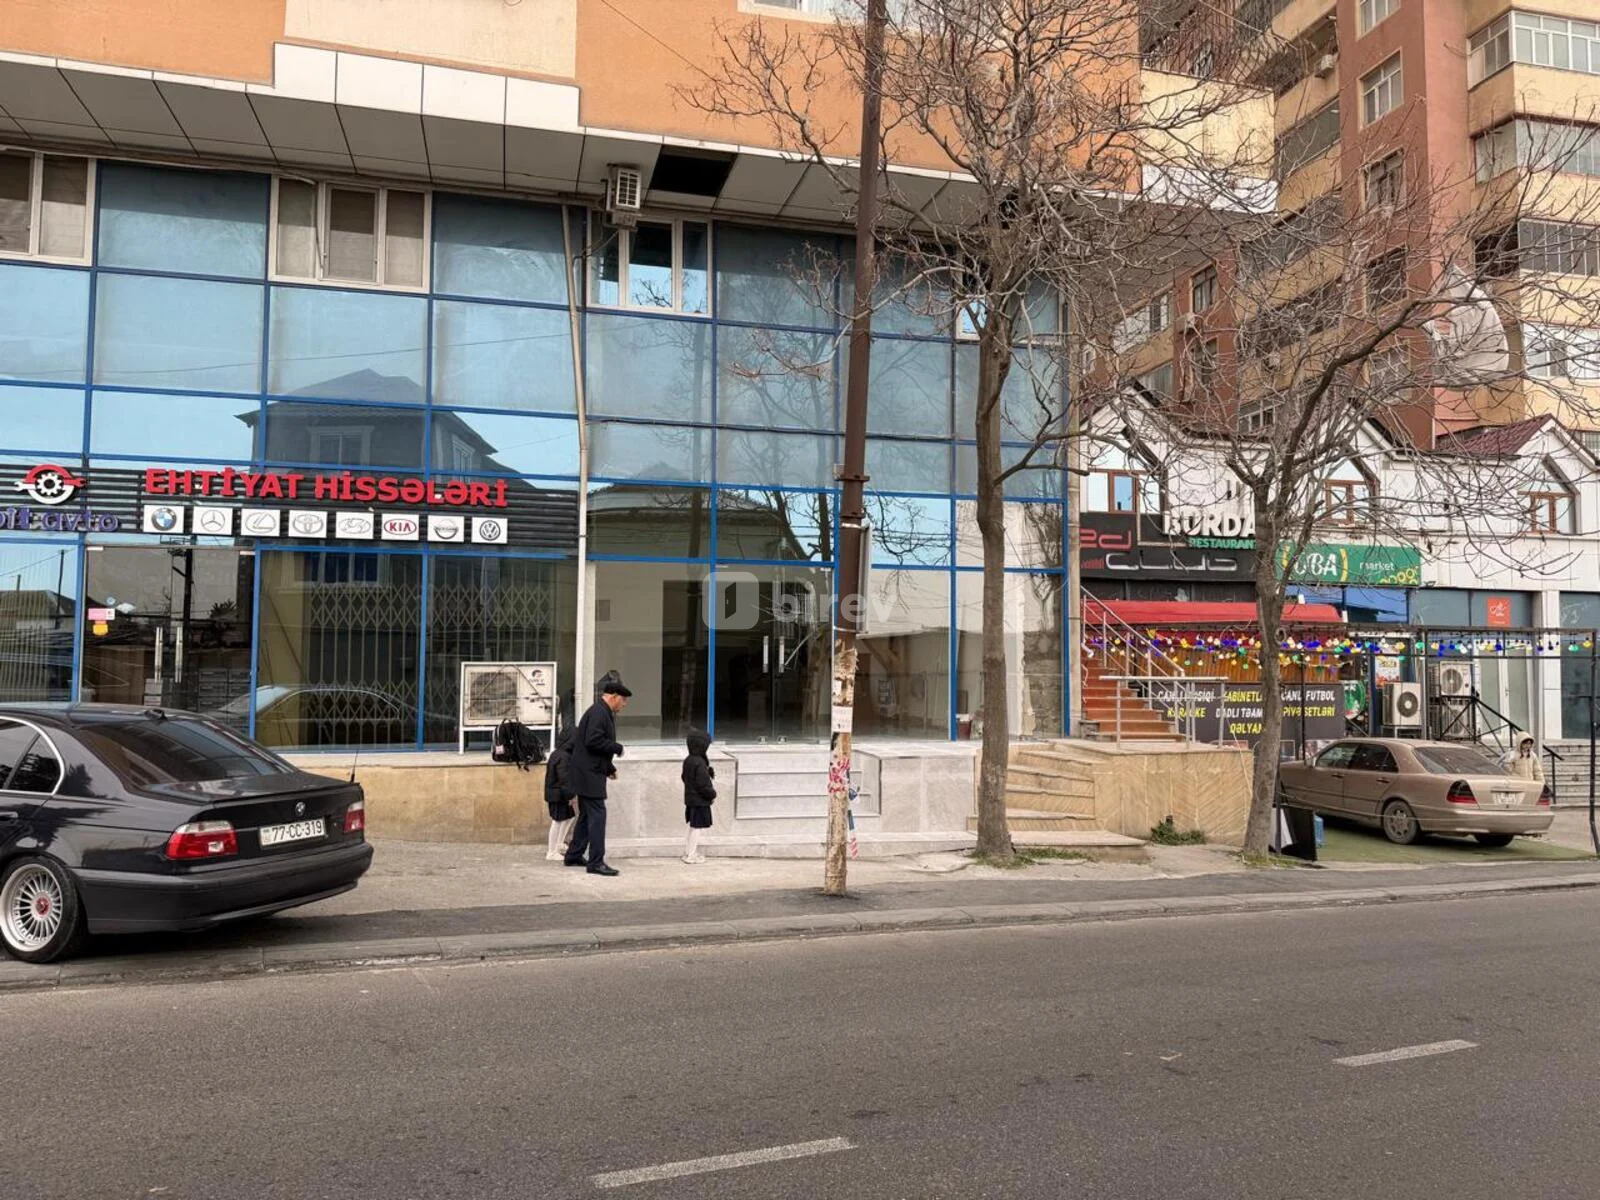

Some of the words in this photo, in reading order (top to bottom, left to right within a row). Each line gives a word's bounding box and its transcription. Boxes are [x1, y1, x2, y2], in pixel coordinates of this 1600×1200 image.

[145, 467, 304, 499] EHTİYAT
[314, 471, 508, 507] HİSSƏLƏRİ
[389, 521, 412, 533] KIA
[1359, 561, 1396, 571] market
[1281, 690, 1301, 701] CANL
[1305, 690, 1336, 701] FUTBOL
[272, 820, 322, 842] 77-CC-319
